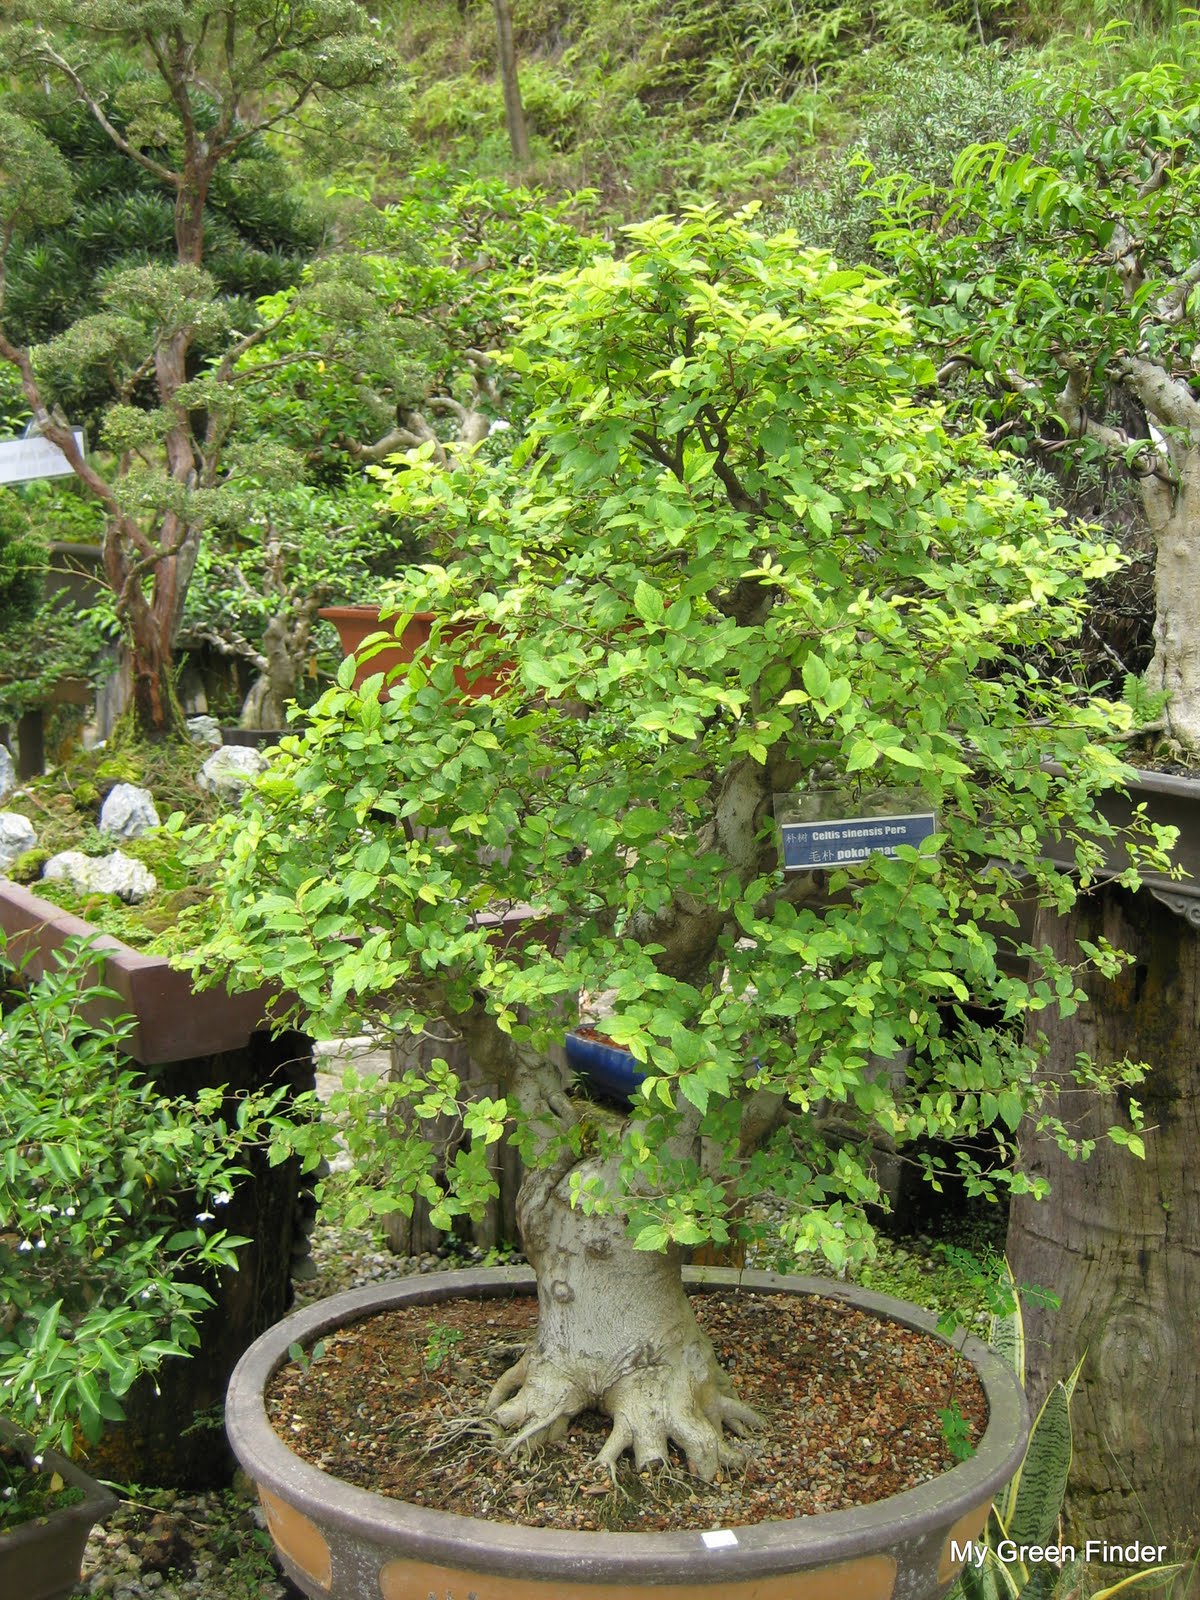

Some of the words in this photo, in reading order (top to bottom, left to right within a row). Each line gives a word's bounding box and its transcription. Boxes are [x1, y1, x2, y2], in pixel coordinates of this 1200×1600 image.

[812, 830, 840, 841] Celtis
[842, 827, 883, 838] sinensis
[885, 825, 907, 835] Pers
[837, 847, 871, 860] pokok
